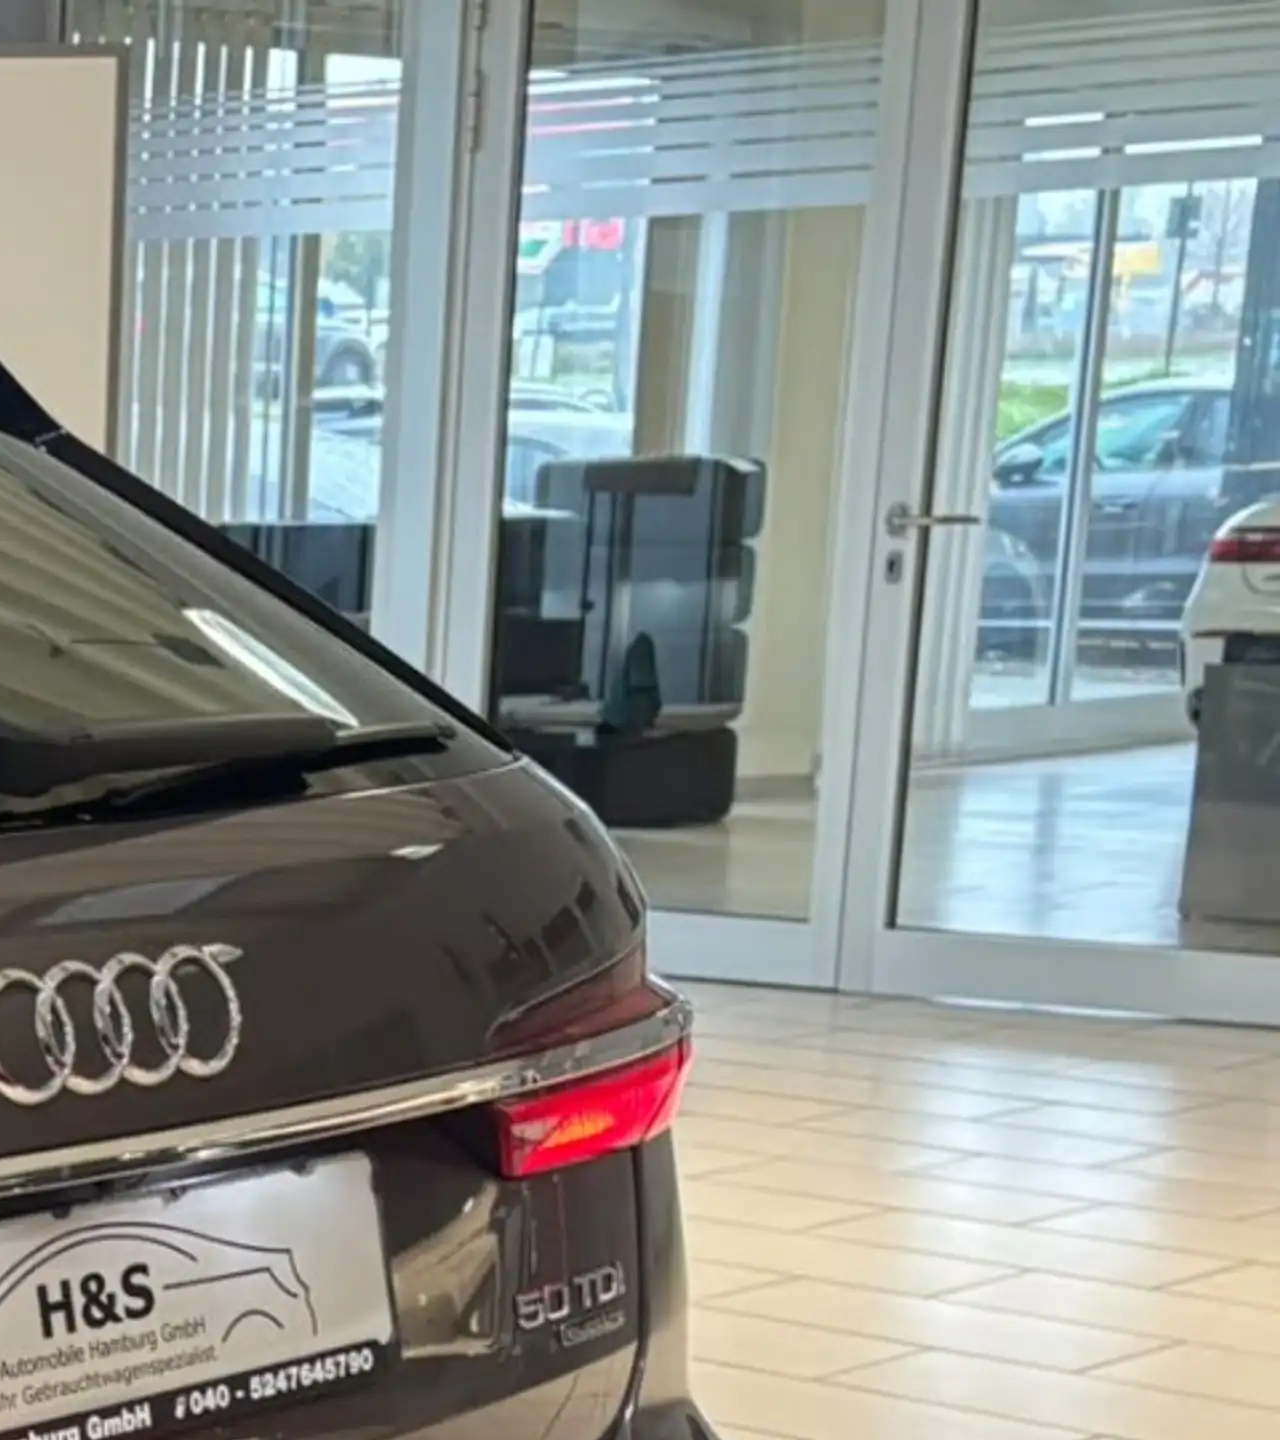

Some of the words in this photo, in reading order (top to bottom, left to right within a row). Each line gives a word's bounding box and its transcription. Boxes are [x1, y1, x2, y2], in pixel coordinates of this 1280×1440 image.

[36, 1262, 155, 1339] H&S
[515, 1283, 570, 1330] 50
[573, 1260, 627, 1308] TDI
[0, 1343, 85, 1381] Automobile
[89, 1332, 158, 1360] Hamburg
[160, 1315, 207, 1343] GmbH
[86, 1402, 153, 1440] GmbH
[190, 1384, 231, 1416] 040
[249, 1348, 375, 1400] 5247645790
